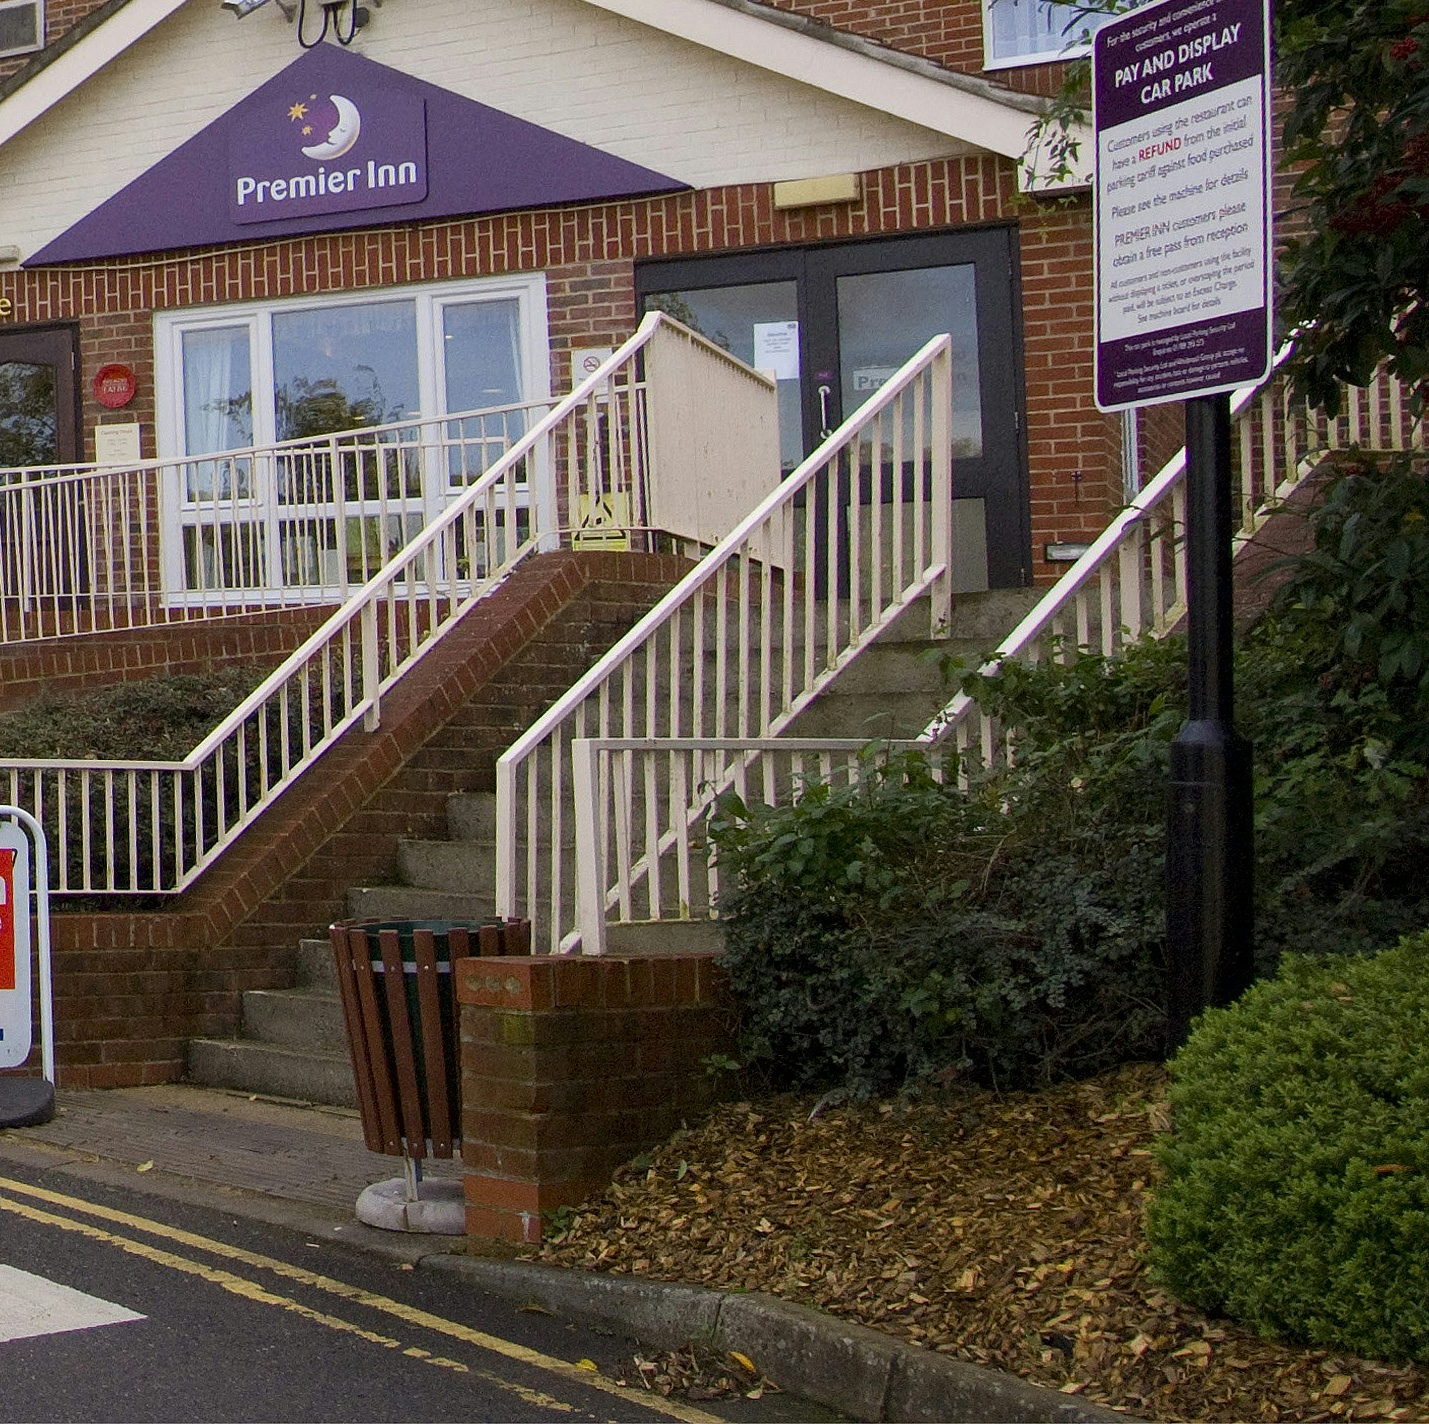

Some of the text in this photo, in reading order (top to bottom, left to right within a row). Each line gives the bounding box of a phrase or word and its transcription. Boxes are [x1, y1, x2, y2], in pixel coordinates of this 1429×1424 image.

[1115, 22, 1241, 88] PAY AND DISPLAY
[1141, 62, 1213, 104] CAR PARK
[1107, 131, 1150, 153] Customers
[1152, 123, 1173, 138] using
[1175, 117, 1189, 130] the
[1191, 101, 1235, 124] restaurant
[1139, 137, 1181, 161] REFUND
[1184, 133, 1204, 147] from
[1206, 126, 1221, 140] the
[237, 160, 417, 206] Premier Inn
[1107, 175, 1136, 195] parking
[1187, 150, 1207, 166] food
[1209, 134, 1254, 161] purchased
[1112, 167, 1248, 219] Please see the machine for details
[1115, 202, 1246, 246] PREMIER INN customers please
[1146, 246, 1162, 258] free
[1164, 241, 1182, 258] pass
[1183, 235, 1204, 248] from
[1206, 223, 1248, 242] reception
